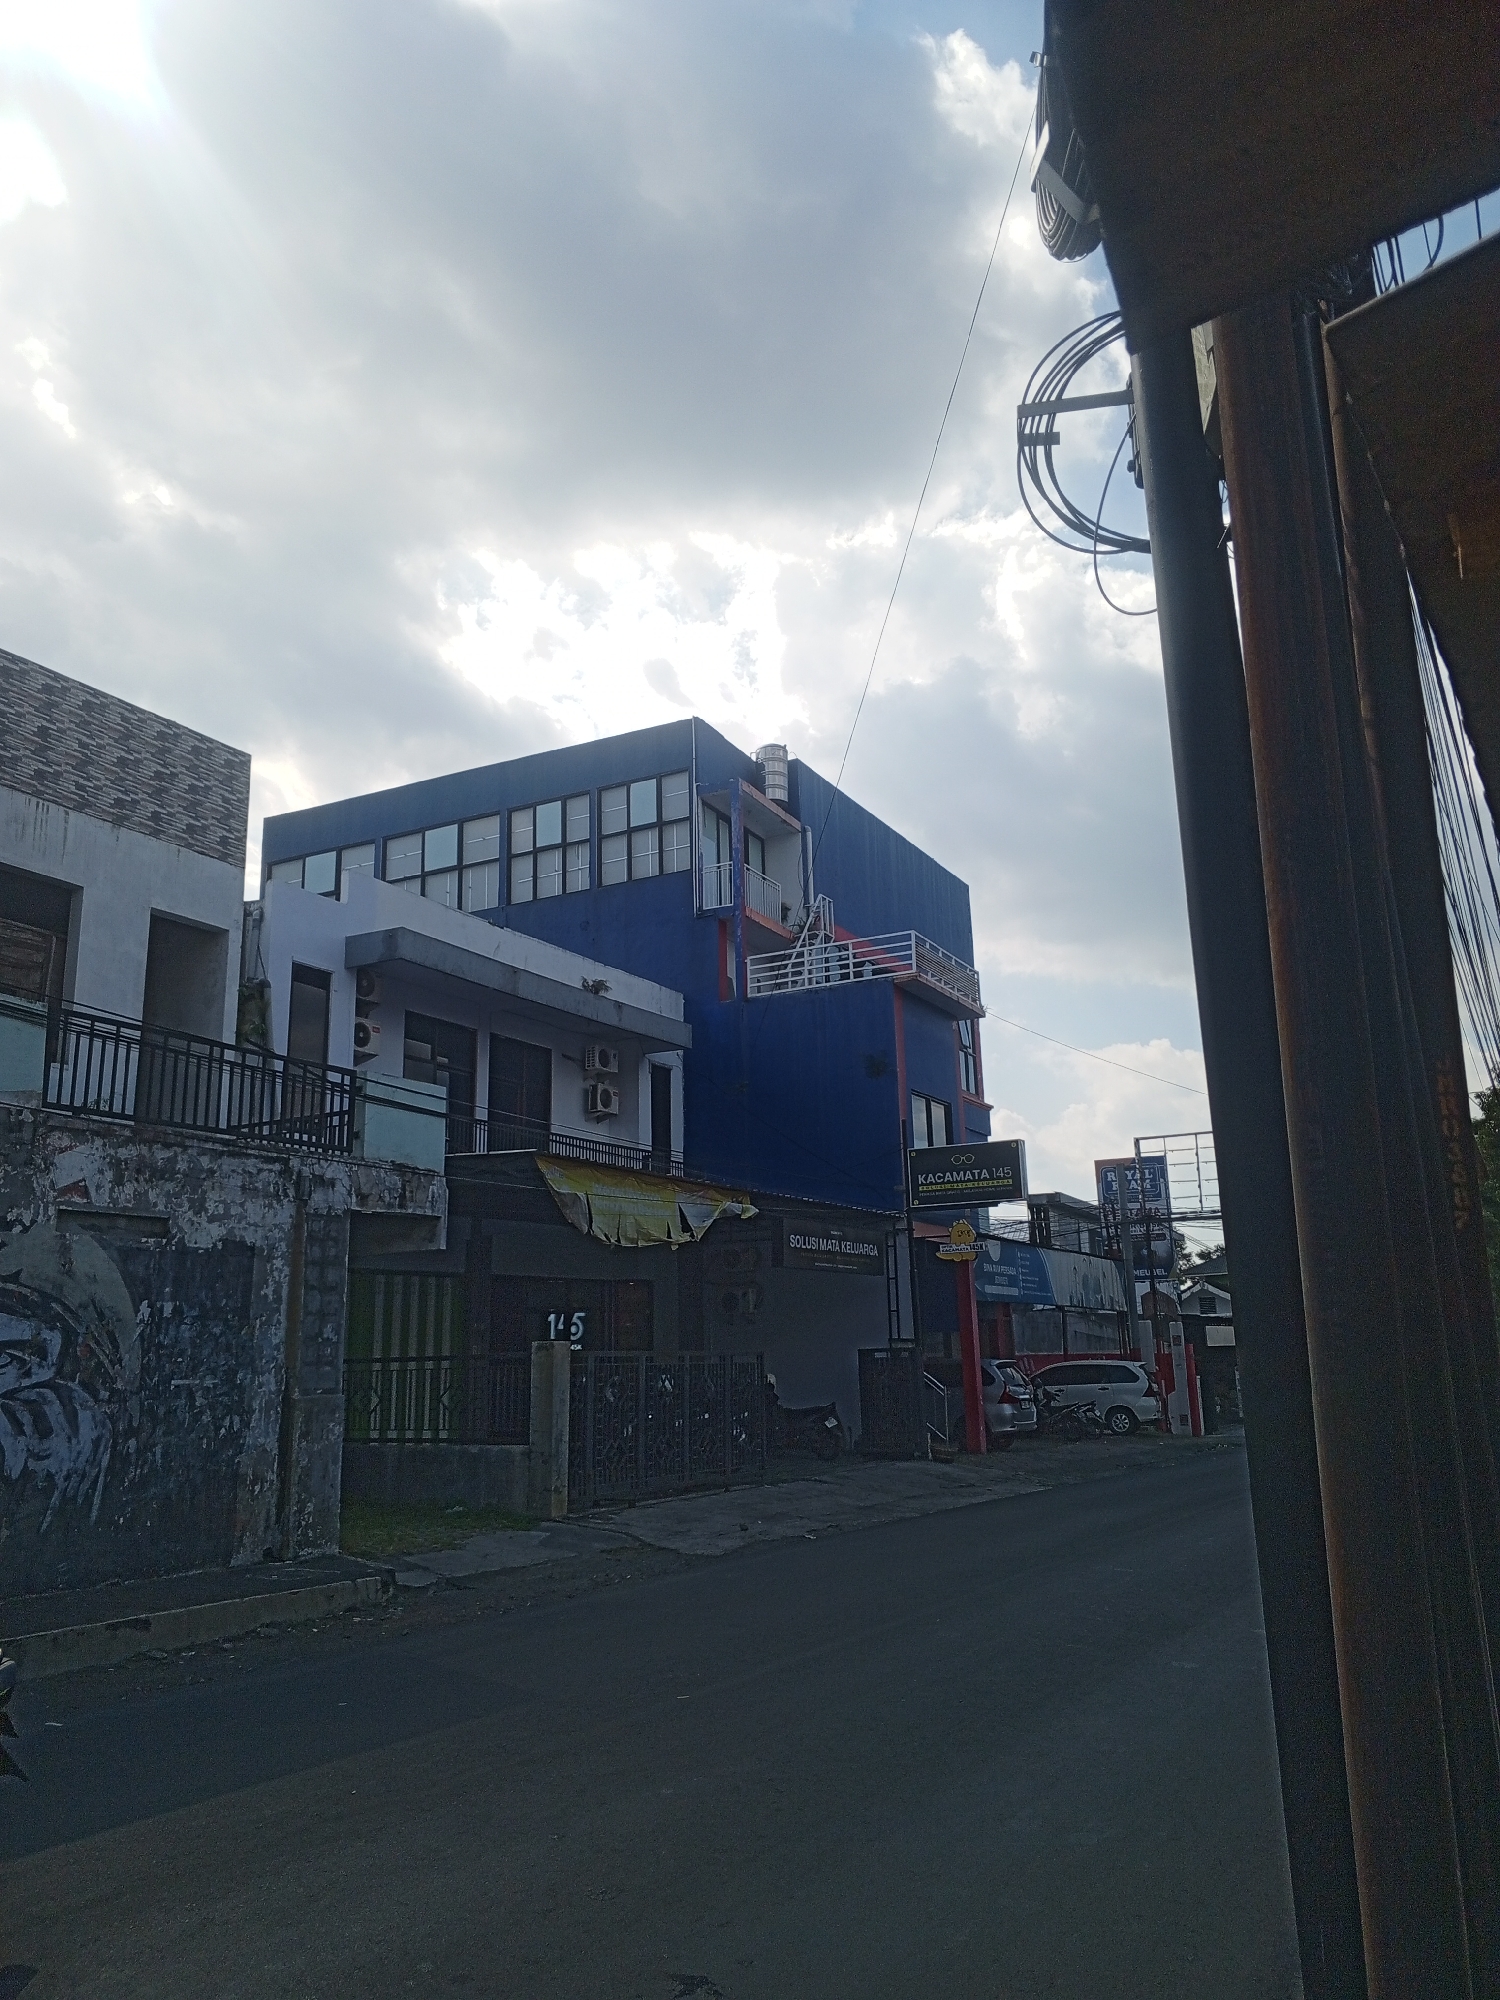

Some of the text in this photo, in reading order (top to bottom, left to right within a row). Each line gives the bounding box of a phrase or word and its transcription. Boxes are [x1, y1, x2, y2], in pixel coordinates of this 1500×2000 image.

[918, 1166, 1013, 1185] KACAMATA 145
[789, 1234, 819, 1251] SOLUSI
[820, 1238, 841, 1253] MATA
[841, 1240, 879, 1257] KELUARGA
